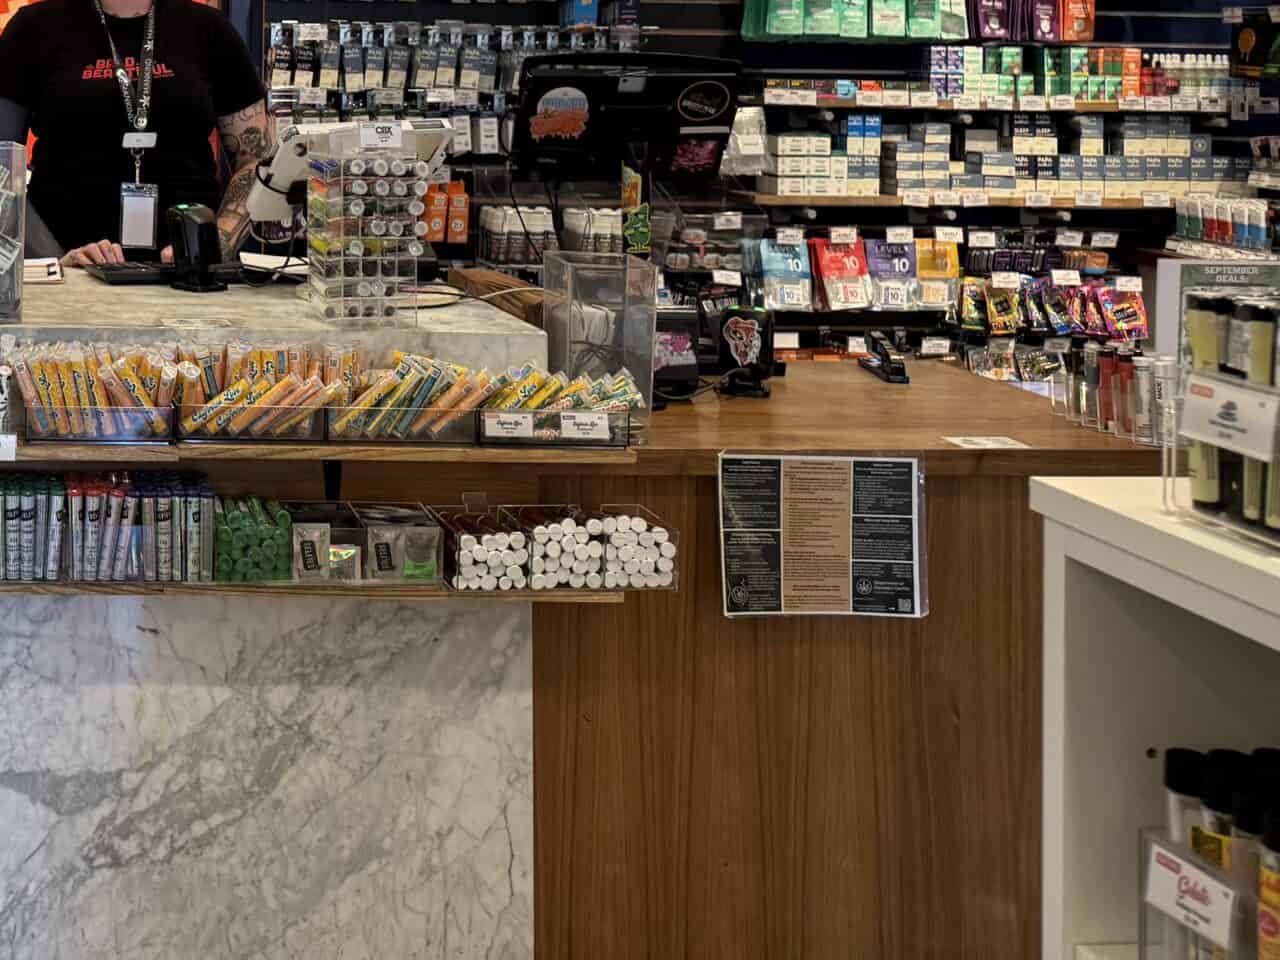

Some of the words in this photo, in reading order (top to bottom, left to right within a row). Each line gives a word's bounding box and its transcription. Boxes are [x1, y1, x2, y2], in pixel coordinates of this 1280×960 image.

[82, 62, 174, 80] BEATIUL
[787, 258, 802, 272] 10
[842, 256, 859, 270] 10
[892, 258, 909, 272] 10
[1204, 266, 1259, 275] SEPTEMBER
[785, 290, 794, 300] 10
[890, 291, 899, 301] 10
